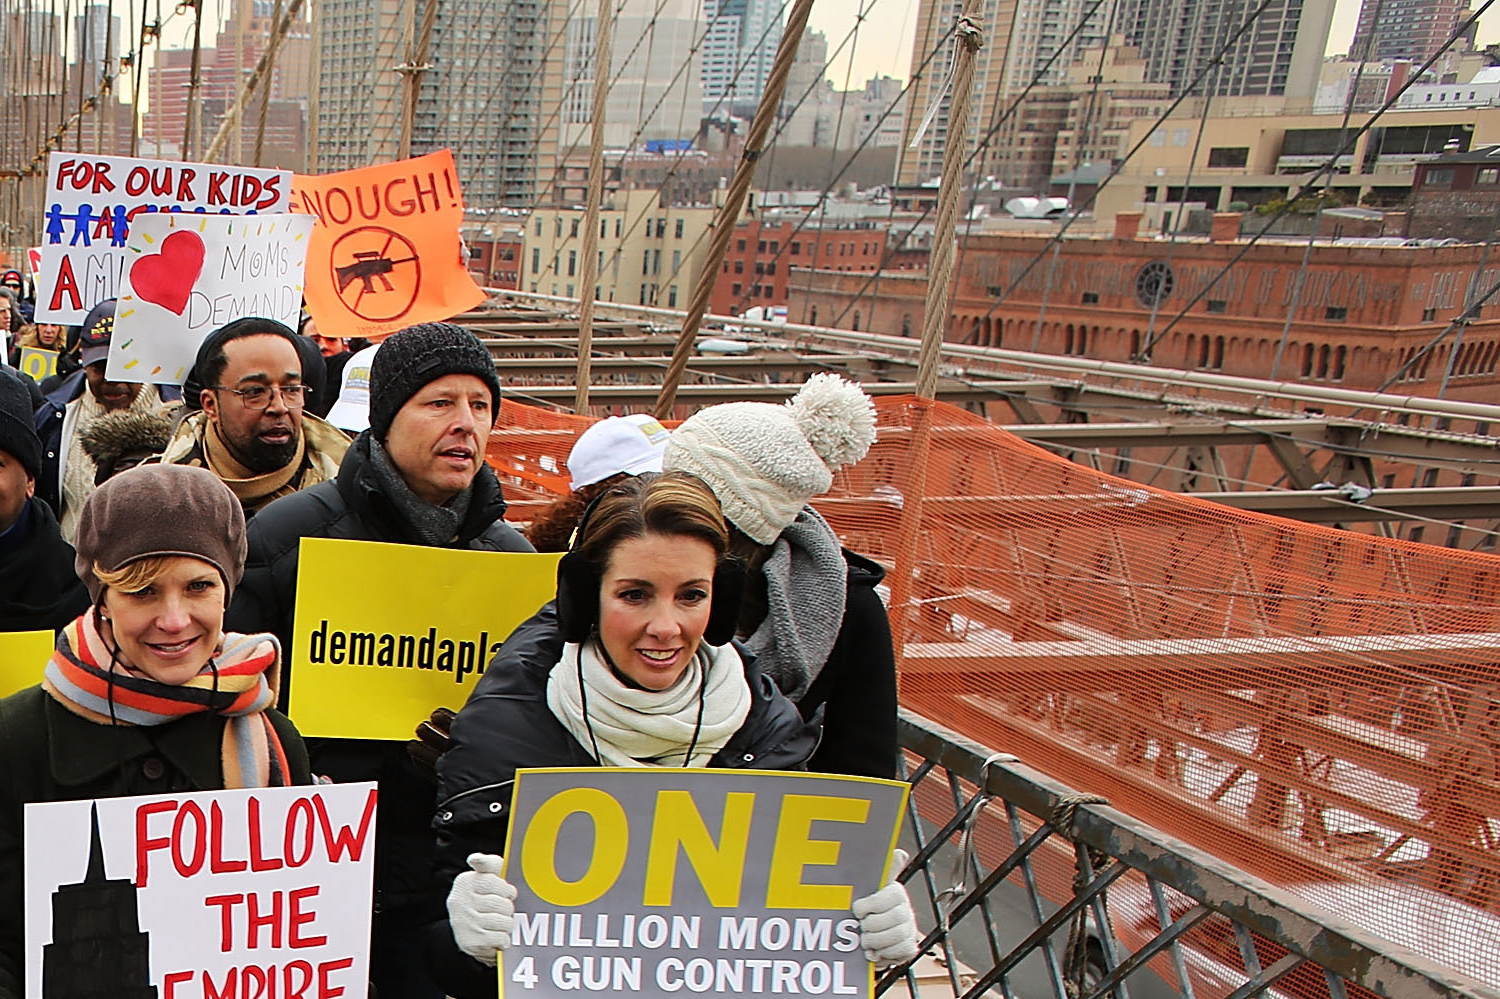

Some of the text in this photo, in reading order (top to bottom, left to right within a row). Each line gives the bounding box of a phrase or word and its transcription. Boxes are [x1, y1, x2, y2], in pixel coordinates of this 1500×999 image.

[56, 159, 281, 210] FOR OUR KIDS
[220, 240, 289, 283] MOMS
[188, 285, 294, 330] DEMAND
[1177, 266, 1250, 302] COMPANY
[1256, 268, 1279, 305] OF
[1283, 270, 1372, 308] BROOKLYN
[135, 788, 379, 888] FOLLOW
[521, 787, 872, 911] ONE
[205, 886, 328, 952] THE
[511, 912, 861, 953] MILLION MOMS
[512, 956, 859, 996] 4 GUN CONTROL
